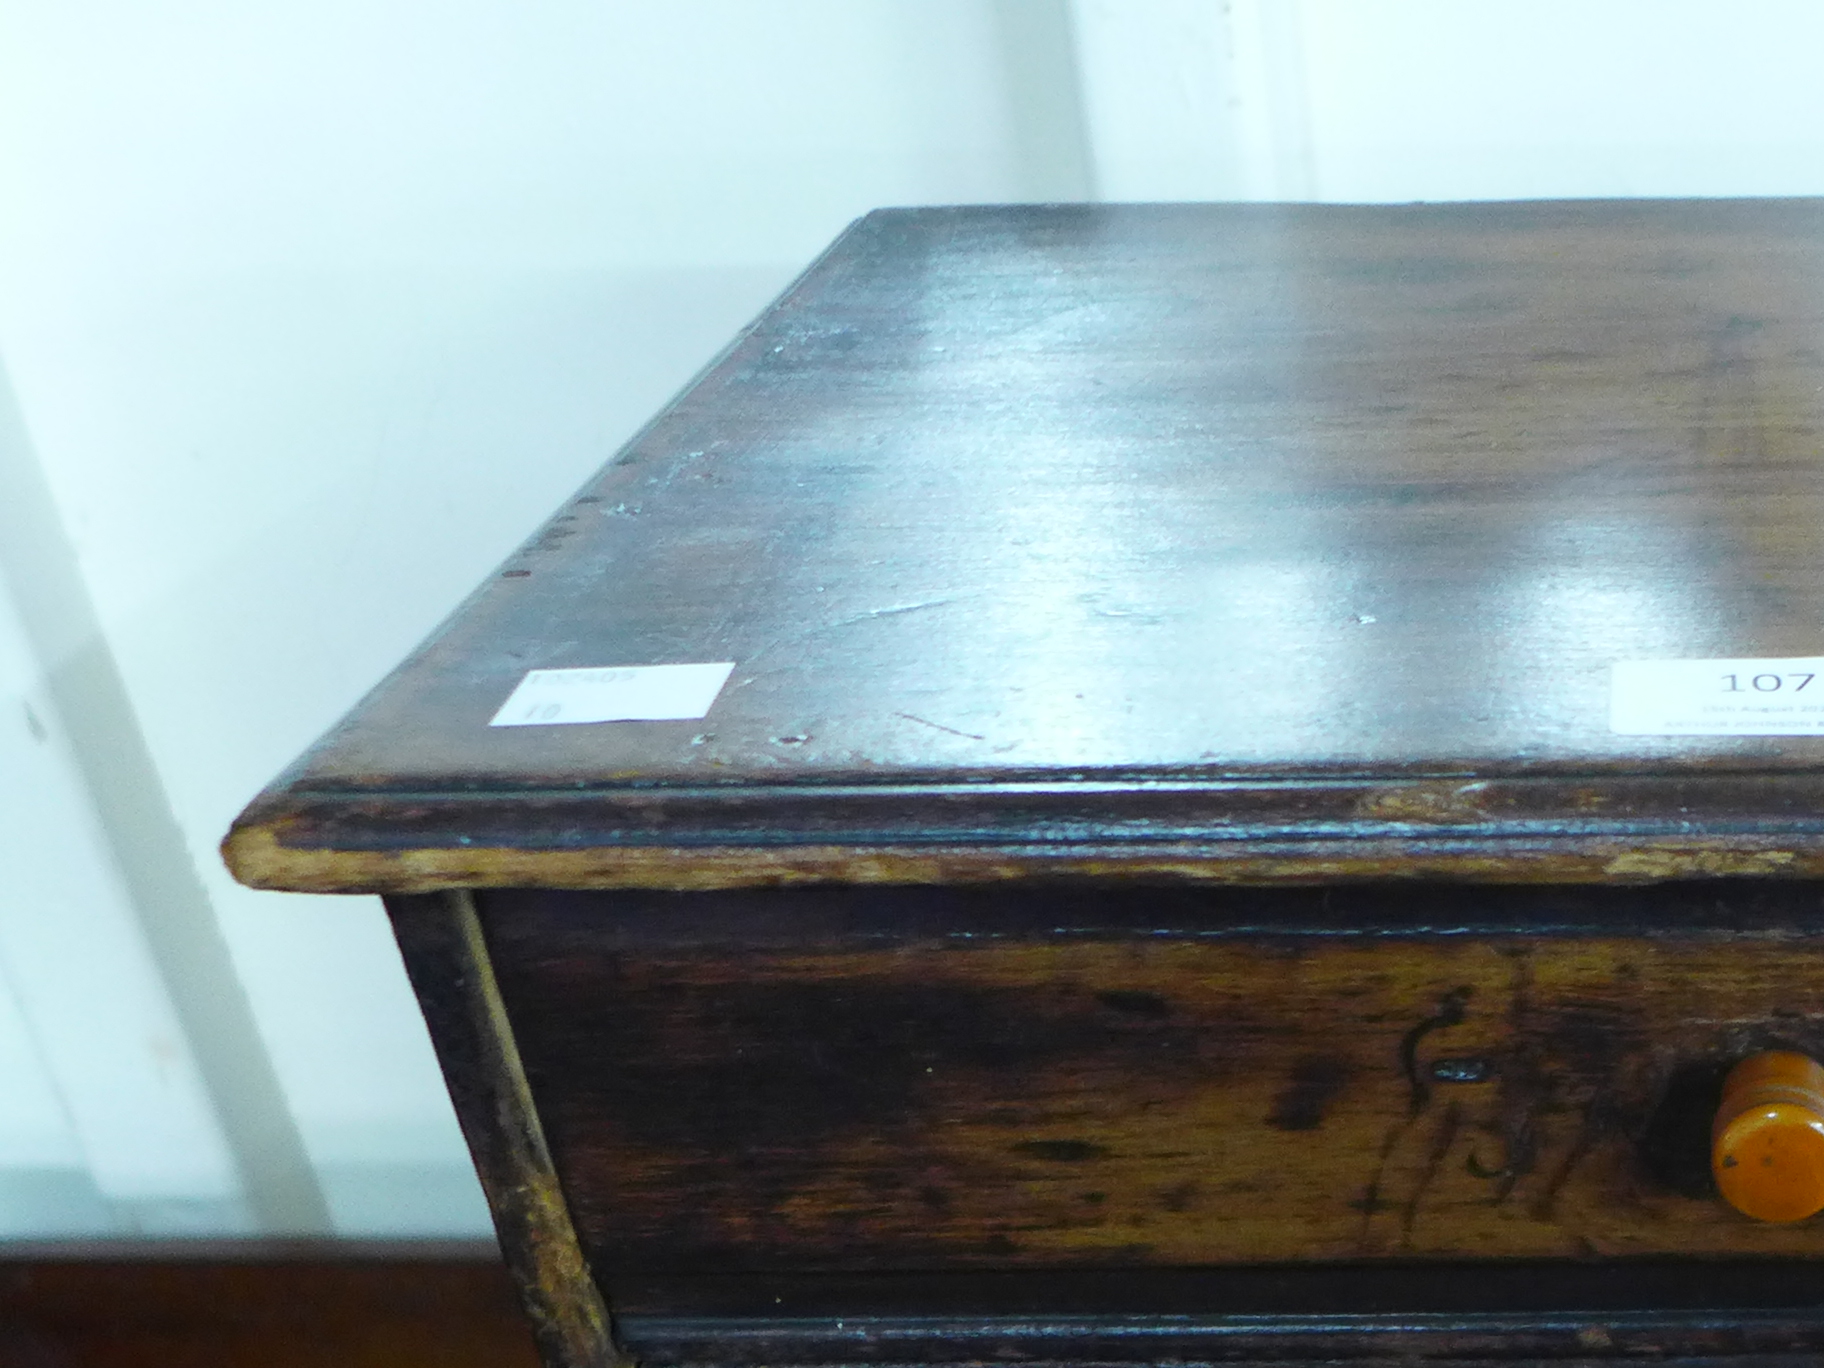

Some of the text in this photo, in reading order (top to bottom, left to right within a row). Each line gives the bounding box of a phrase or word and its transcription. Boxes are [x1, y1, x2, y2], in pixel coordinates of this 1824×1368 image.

[1719, 673, 1816, 693] 107
[523, 702, 562, 719] 10
[1741, 705, 1794, 714] August
[1735, 720, 1812, 728] JOHNSON
